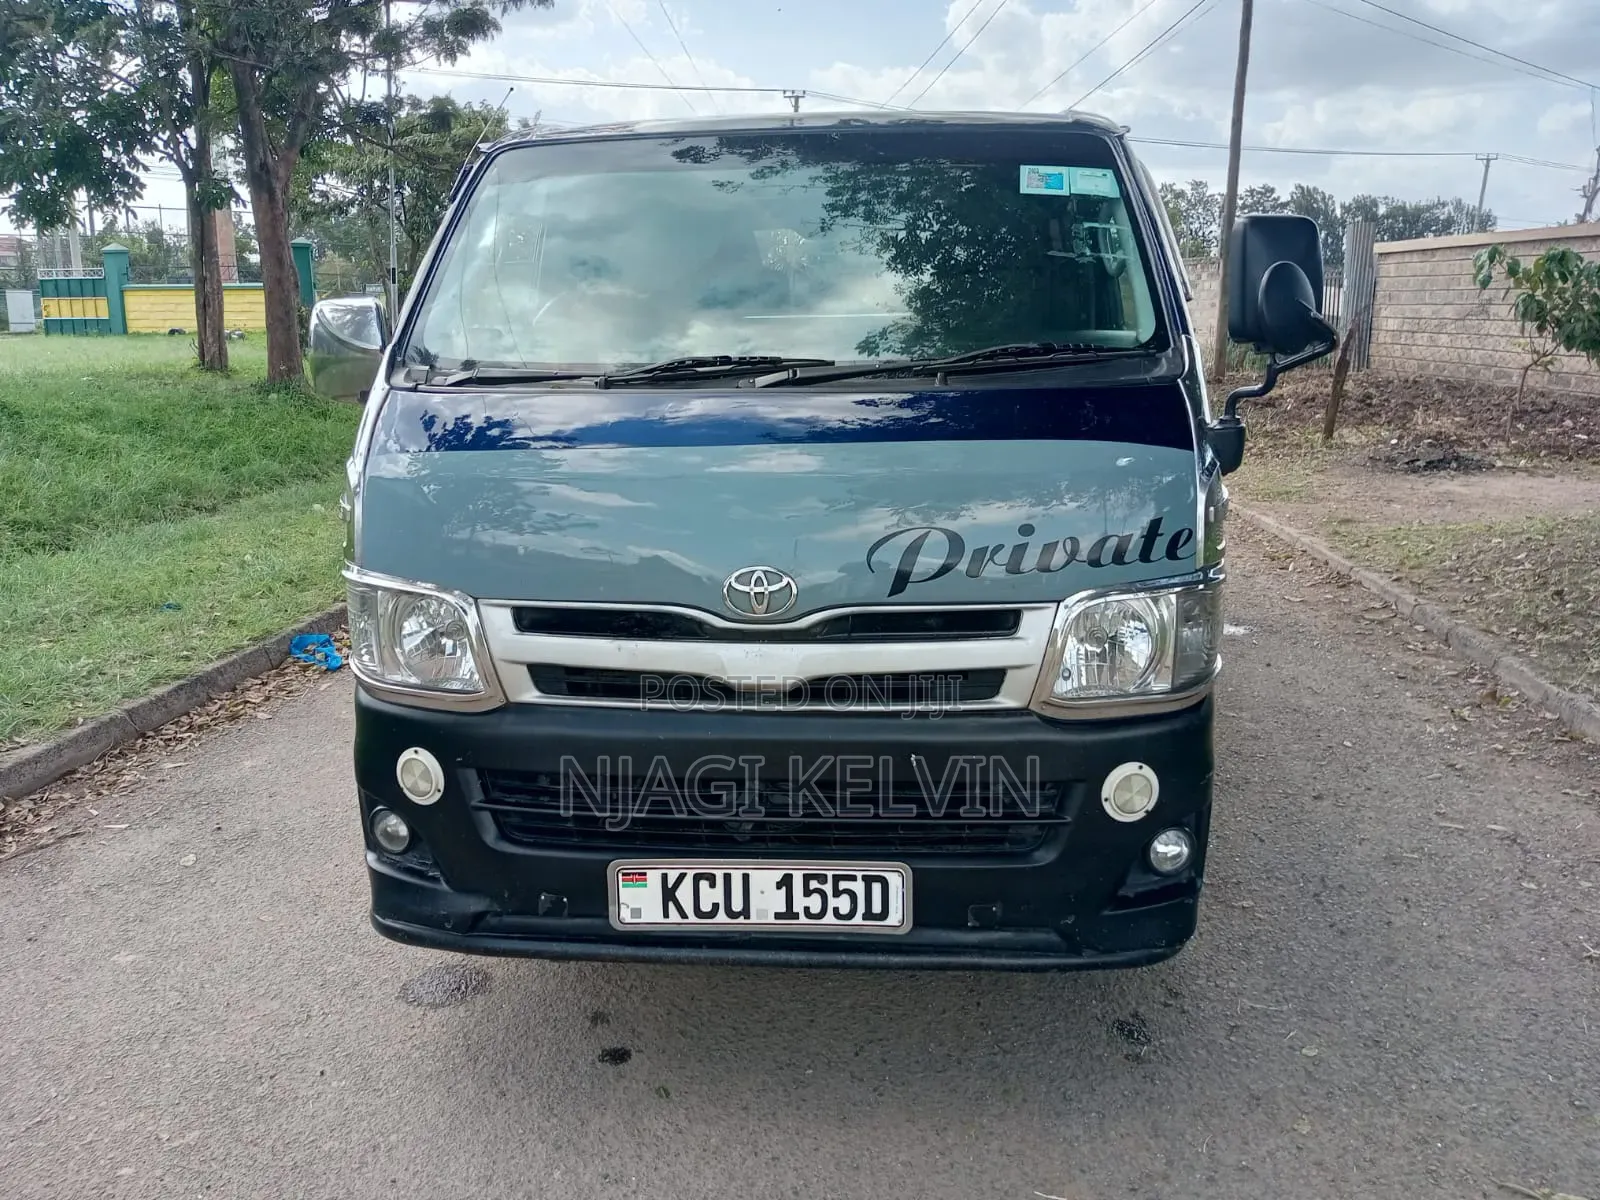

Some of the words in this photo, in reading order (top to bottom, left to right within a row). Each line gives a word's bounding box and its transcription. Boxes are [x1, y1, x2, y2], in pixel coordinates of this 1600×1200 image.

[866, 517, 1196, 597] Private
[661, 872, 751, 920] KCU
[774, 873, 890, 921] 155D
